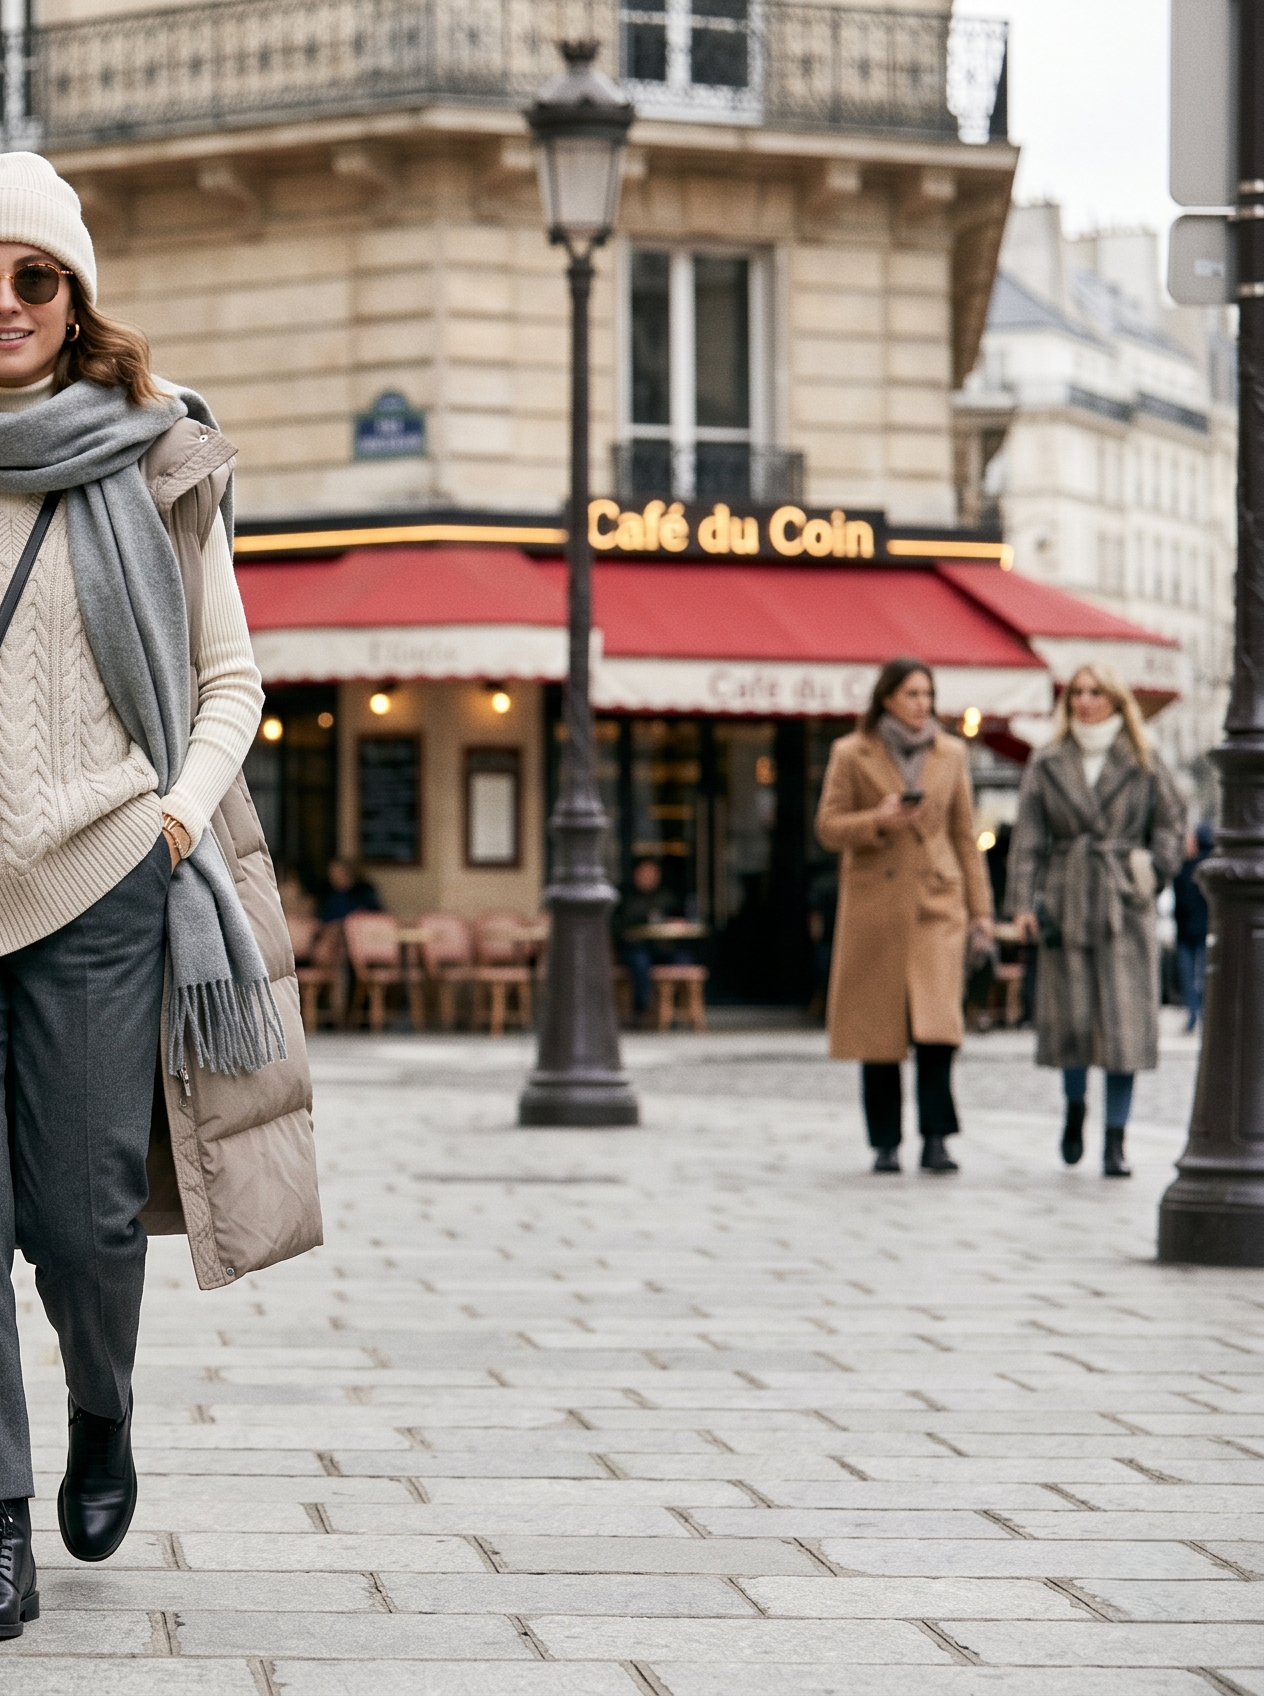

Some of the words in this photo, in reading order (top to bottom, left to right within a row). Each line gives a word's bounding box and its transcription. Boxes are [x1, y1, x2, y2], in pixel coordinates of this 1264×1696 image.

[587, 499, 690, 553] Café
[697, 502, 760, 555] du
[769, 505, 875, 559] Coin
